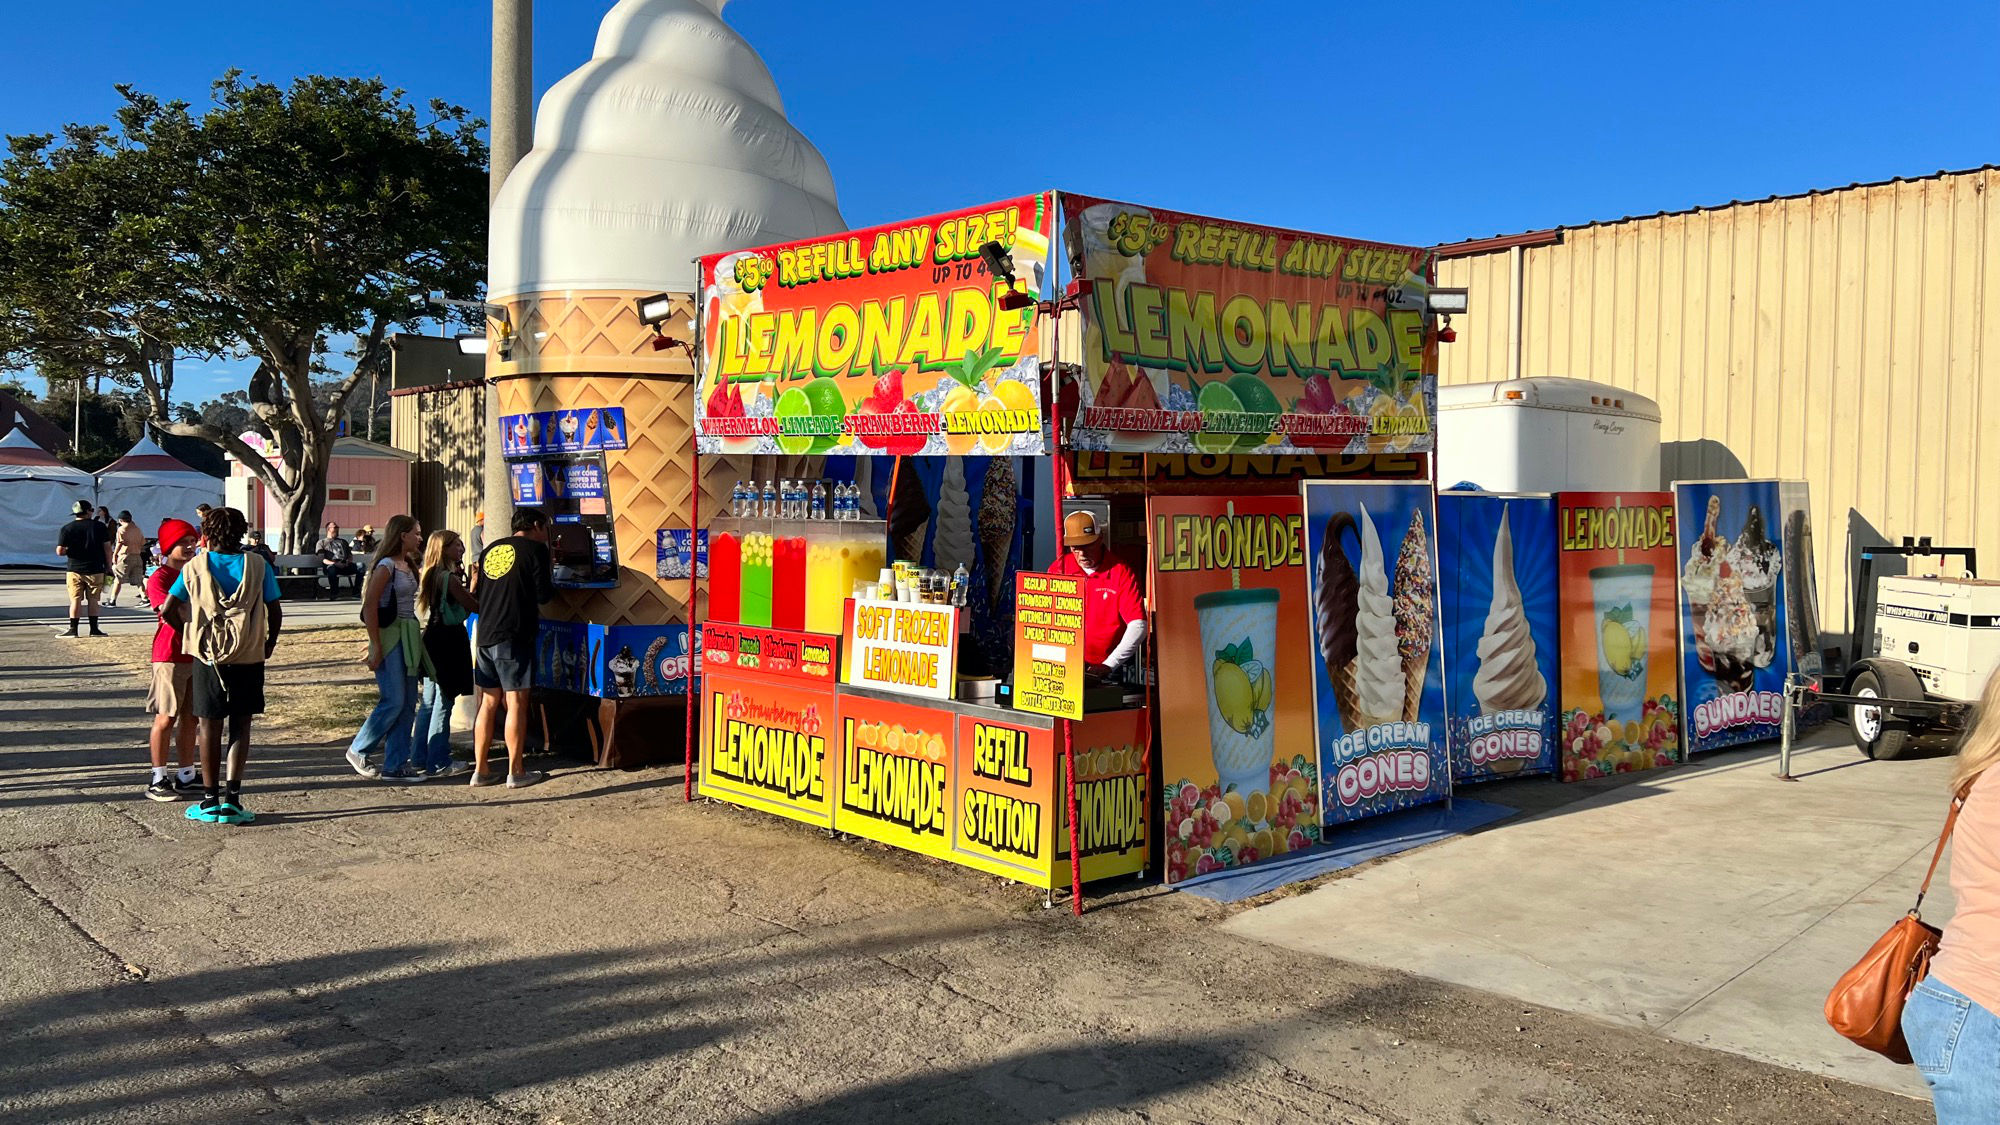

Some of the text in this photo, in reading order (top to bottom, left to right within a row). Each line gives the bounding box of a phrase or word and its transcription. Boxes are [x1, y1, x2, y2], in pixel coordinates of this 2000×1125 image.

[778, 238, 865, 287] REFILL
[870, 225, 930, 273] ANY
[935, 207, 1020, 261] SIZE!
[1172, 222, 1278, 272] REFILL
[1282, 239, 1344, 278] ANY
[1344, 248, 1412, 285] SIZE!
[932, 266, 951, 284] UP
[955, 262, 973, 281] TO
[715, 279, 1028, 385] LEMONADE
[1093, 277, 1425, 381] LEMONADE
[1156, 514, 1304, 572] LEMONADE
[1561, 504, 1675, 553] LEMONADE
[1018, 593, 1083, 611] STRAWBERRY LEMONADE
[1049, 578, 1077, 594] LEMONADE
[856, 604, 951, 648] SOFT FROZEN
[1018, 609, 1082, 628] WATERMELON LEMONADE
[1047, 629, 1076, 645] LEMONADE
[863, 647, 938, 689] LEMONADE
[742, 696, 802, 732] Strawberry
[1021, 691, 1043, 708] BOTTLE
[1694, 690, 1784, 739] SUNDAES
[711, 692, 826, 802] LEMONADE
[1332, 721, 1431, 767] ICE CREAM
[1468, 711, 1544, 736] ICE CREAM
[973, 722, 1032, 787] REFILL
[1468, 730, 1543, 766] CONES
[842, 717, 946, 837] LEMONADE
[1336, 750, 1431, 807] CONES
[964, 788, 1041, 860] STATION
